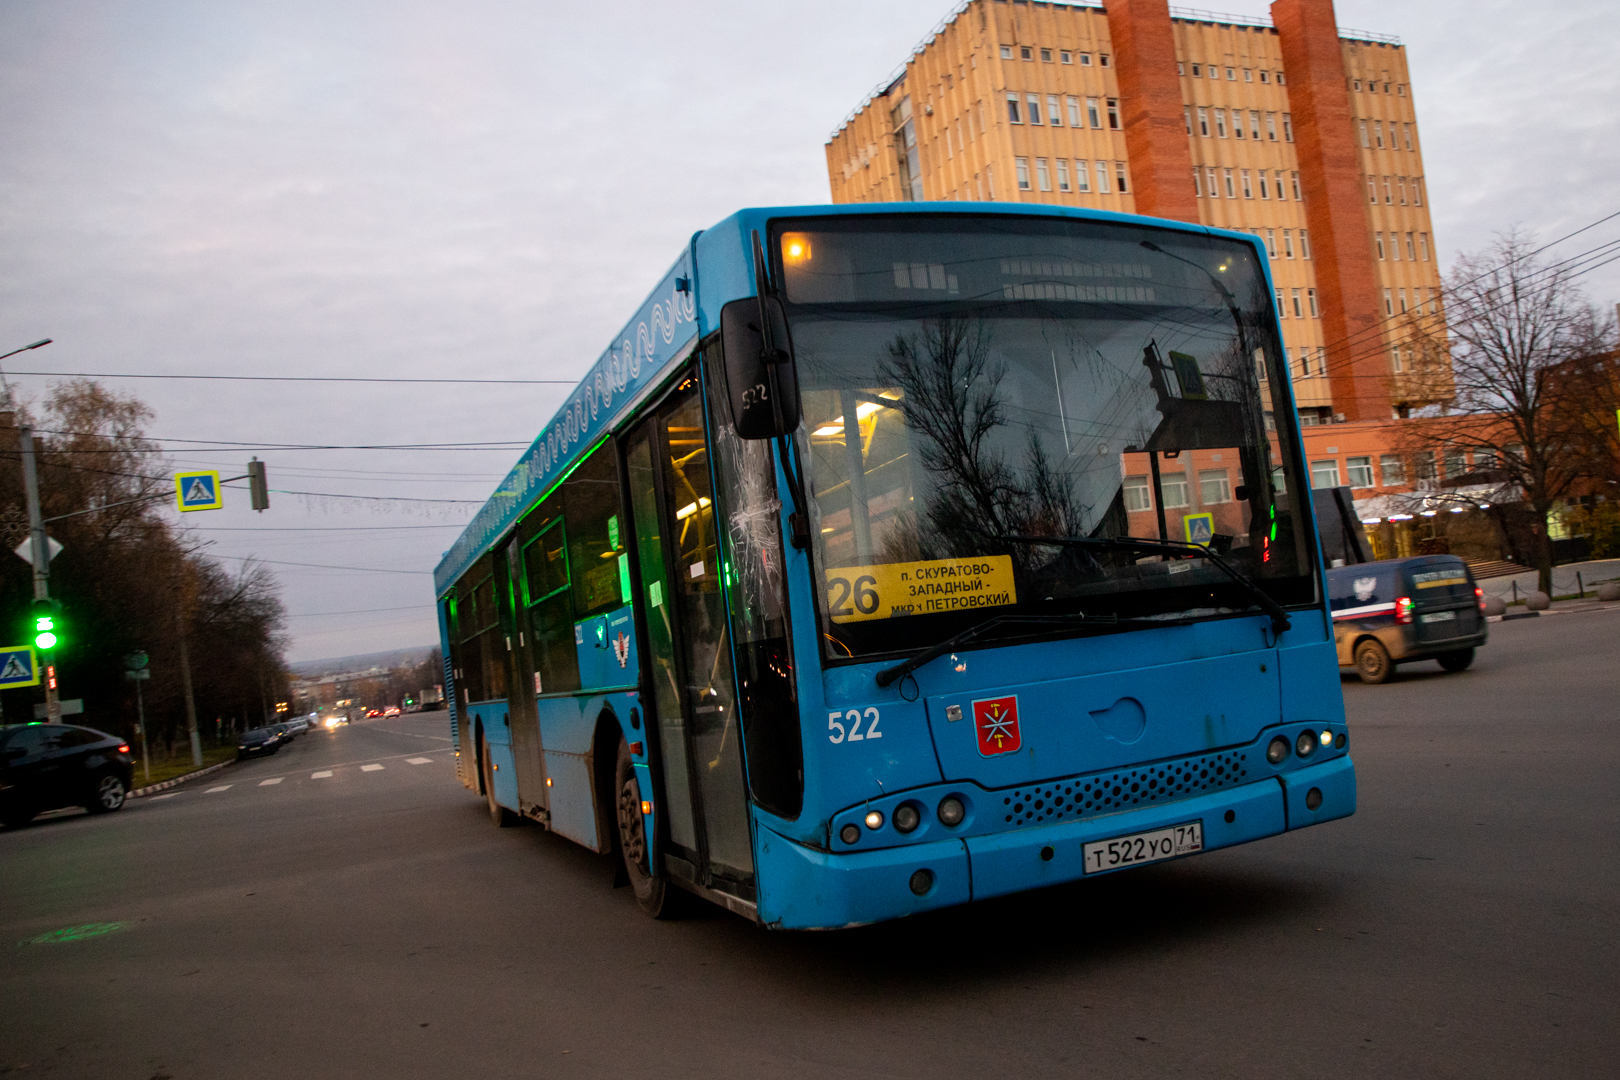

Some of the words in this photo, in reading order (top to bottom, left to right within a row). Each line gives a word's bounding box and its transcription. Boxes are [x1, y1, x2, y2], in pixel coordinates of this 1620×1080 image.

[742, 384, 768, 410] 522
[901, 572, 912, 581] п.
[916, 563, 994, 580] СКУРАТОВО-
[828, 575, 880, 616] 26
[909, 577, 983, 597] ЗАПАДНЫЙ
[926, 590, 1010, 610] ПЕТРОВСКИЙ
[828, 706, 882, 744] 522
[1176, 826, 1195, 845] 71
[1177, 844, 1190, 852] RUS
